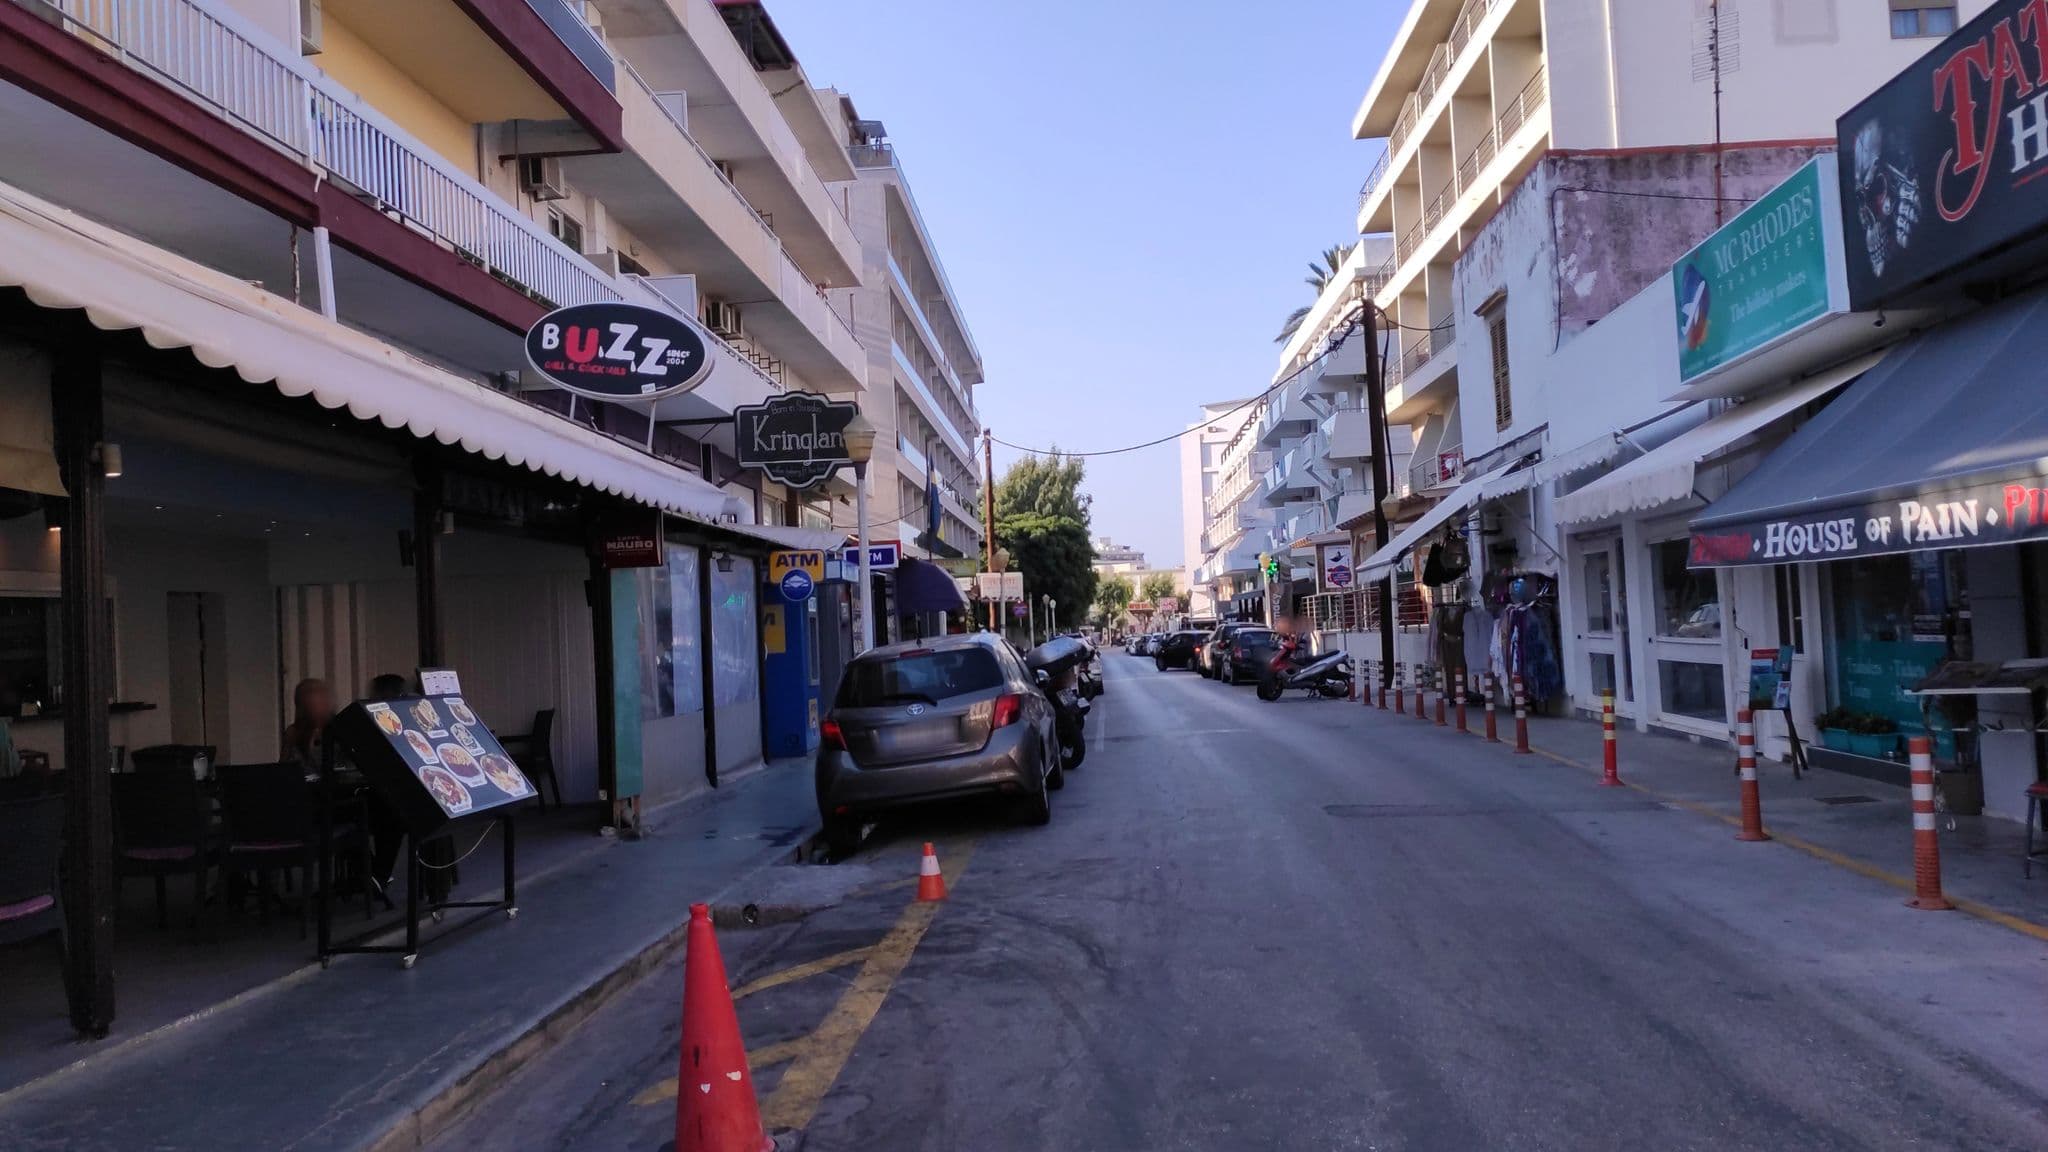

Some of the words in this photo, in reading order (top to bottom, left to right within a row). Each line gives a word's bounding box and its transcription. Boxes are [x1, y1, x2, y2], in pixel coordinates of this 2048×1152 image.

[1714, 238, 1739, 278] MC
[1740, 185, 1814, 262] RHODES
[541, 322, 671, 376] BUZZ
[666, 349, 691, 358] SINCE
[606, 540, 654, 550] MAURO
[1763, 518, 1858, 558] HOUSE
[1899, 499, 1978, 544] PAIN
[776, 553, 819, 567] ATM
